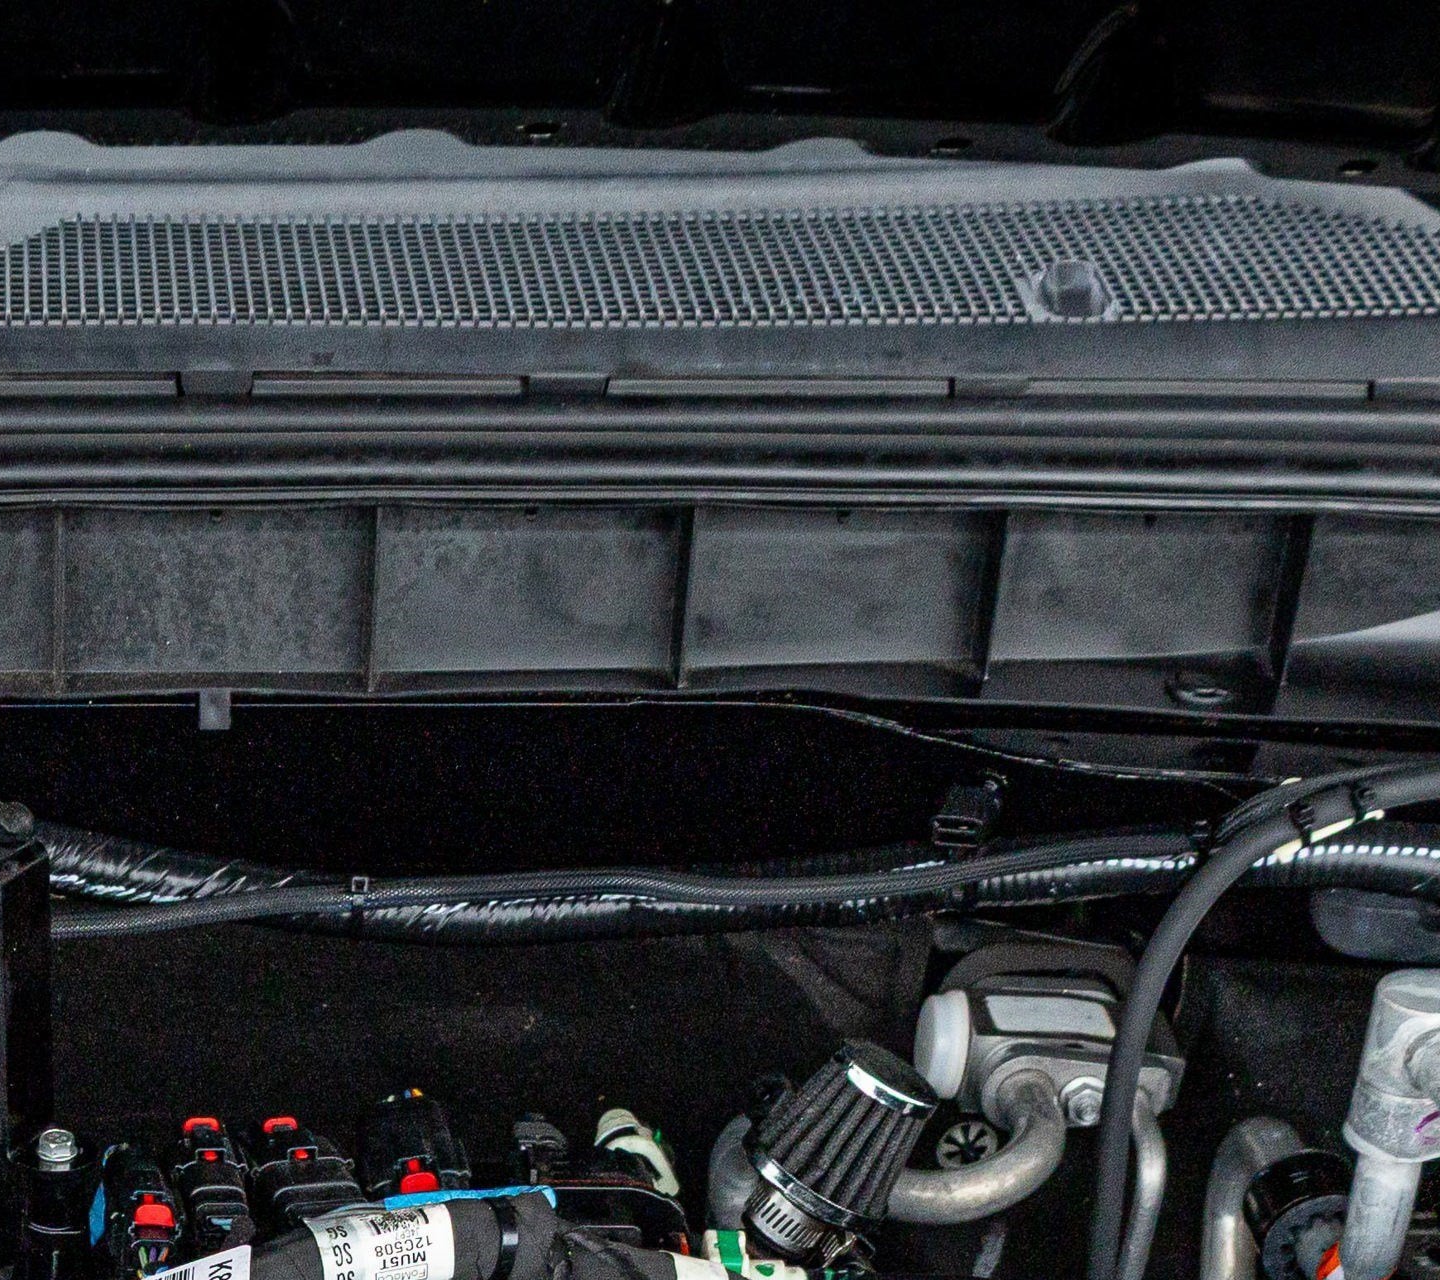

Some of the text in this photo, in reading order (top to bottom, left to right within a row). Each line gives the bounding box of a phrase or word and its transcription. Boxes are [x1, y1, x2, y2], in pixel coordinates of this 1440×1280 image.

[326, 1225, 348, 1239] SG
[333, 1242, 353, 1267] SG
[374, 1235, 433, 1257] 12C508
